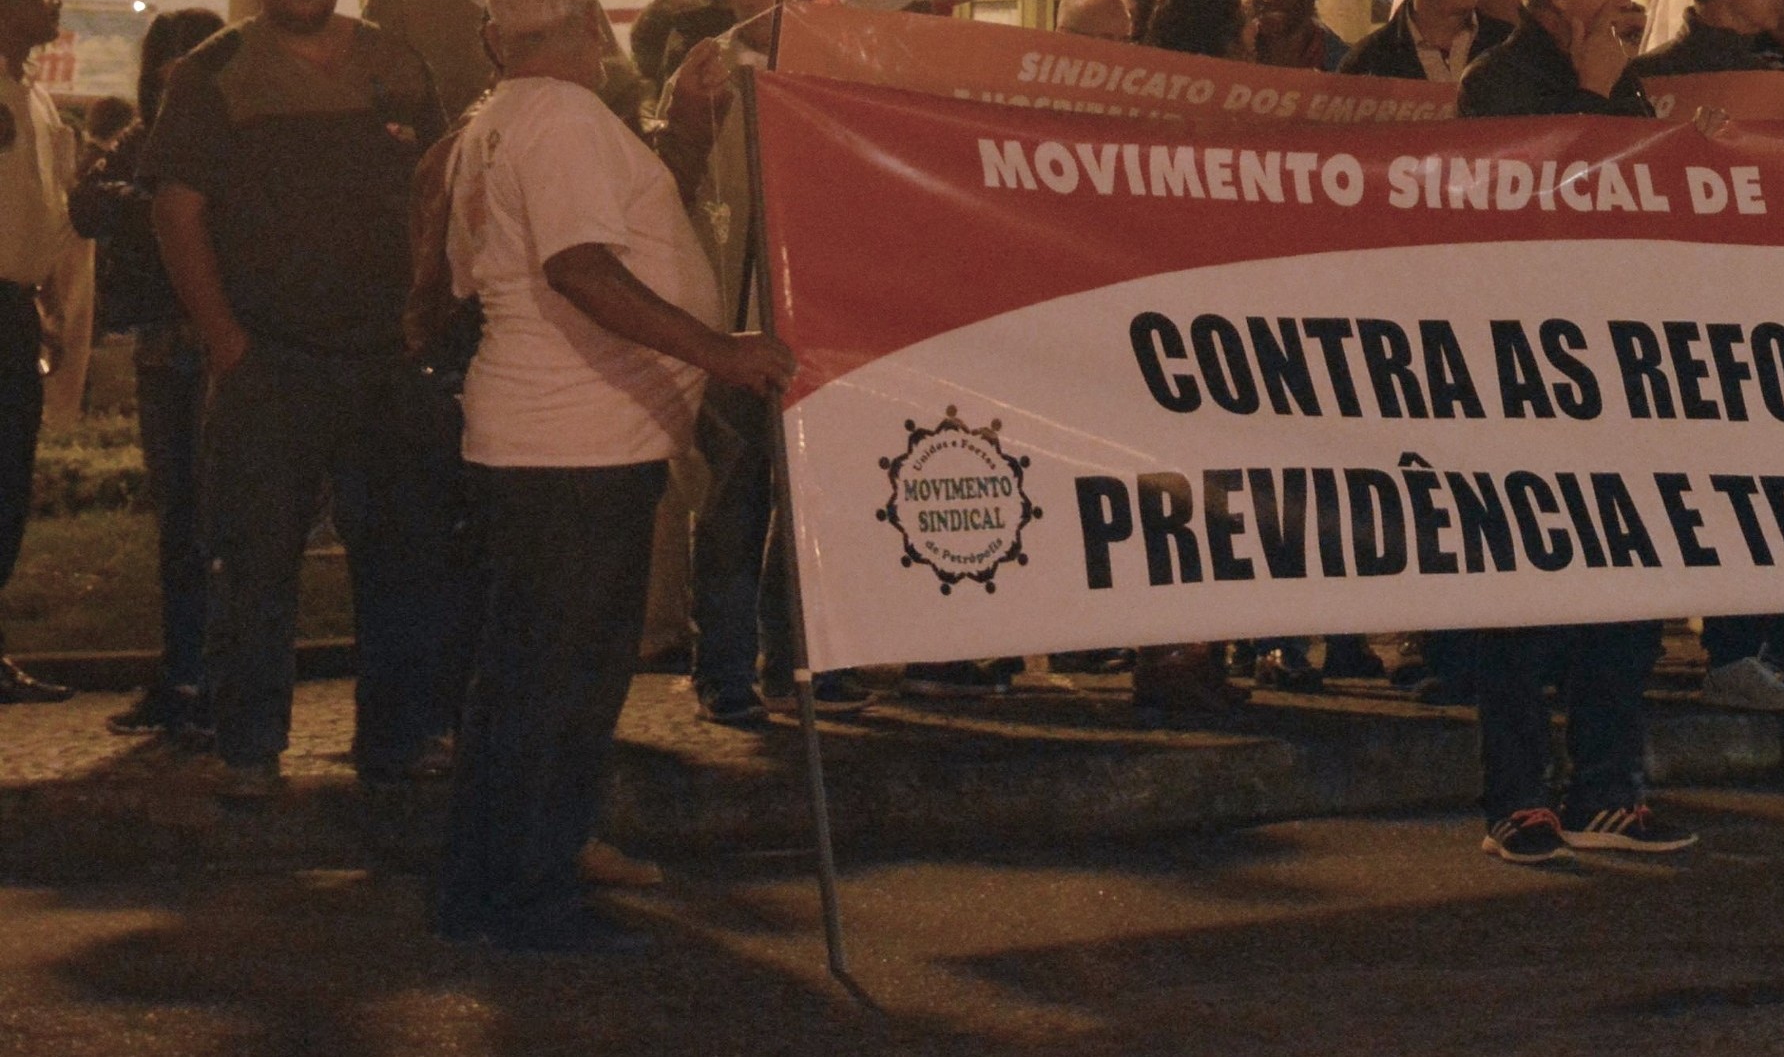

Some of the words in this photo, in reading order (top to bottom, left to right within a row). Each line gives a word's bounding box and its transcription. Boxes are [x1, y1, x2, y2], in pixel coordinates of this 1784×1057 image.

[1017, 51, 1216, 105] SINDICATO
[1222, 83, 1301, 119] DOS
[976, 137, 1365, 206] MOVIMENTO
[1388, 154, 1671, 213] SINDICAL
[1685, 165, 1768, 215] DE
[1129, 310, 1486, 420] CONTRA
[1496, 317, 1604, 420] AS
[904, 475, 1013, 502] MOVIMENTO
[918, 506, 1006, 533] SINDICAL
[1074, 451, 1664, 591] PREVIDÊNCIA
[1662, 472, 1723, 569] E
